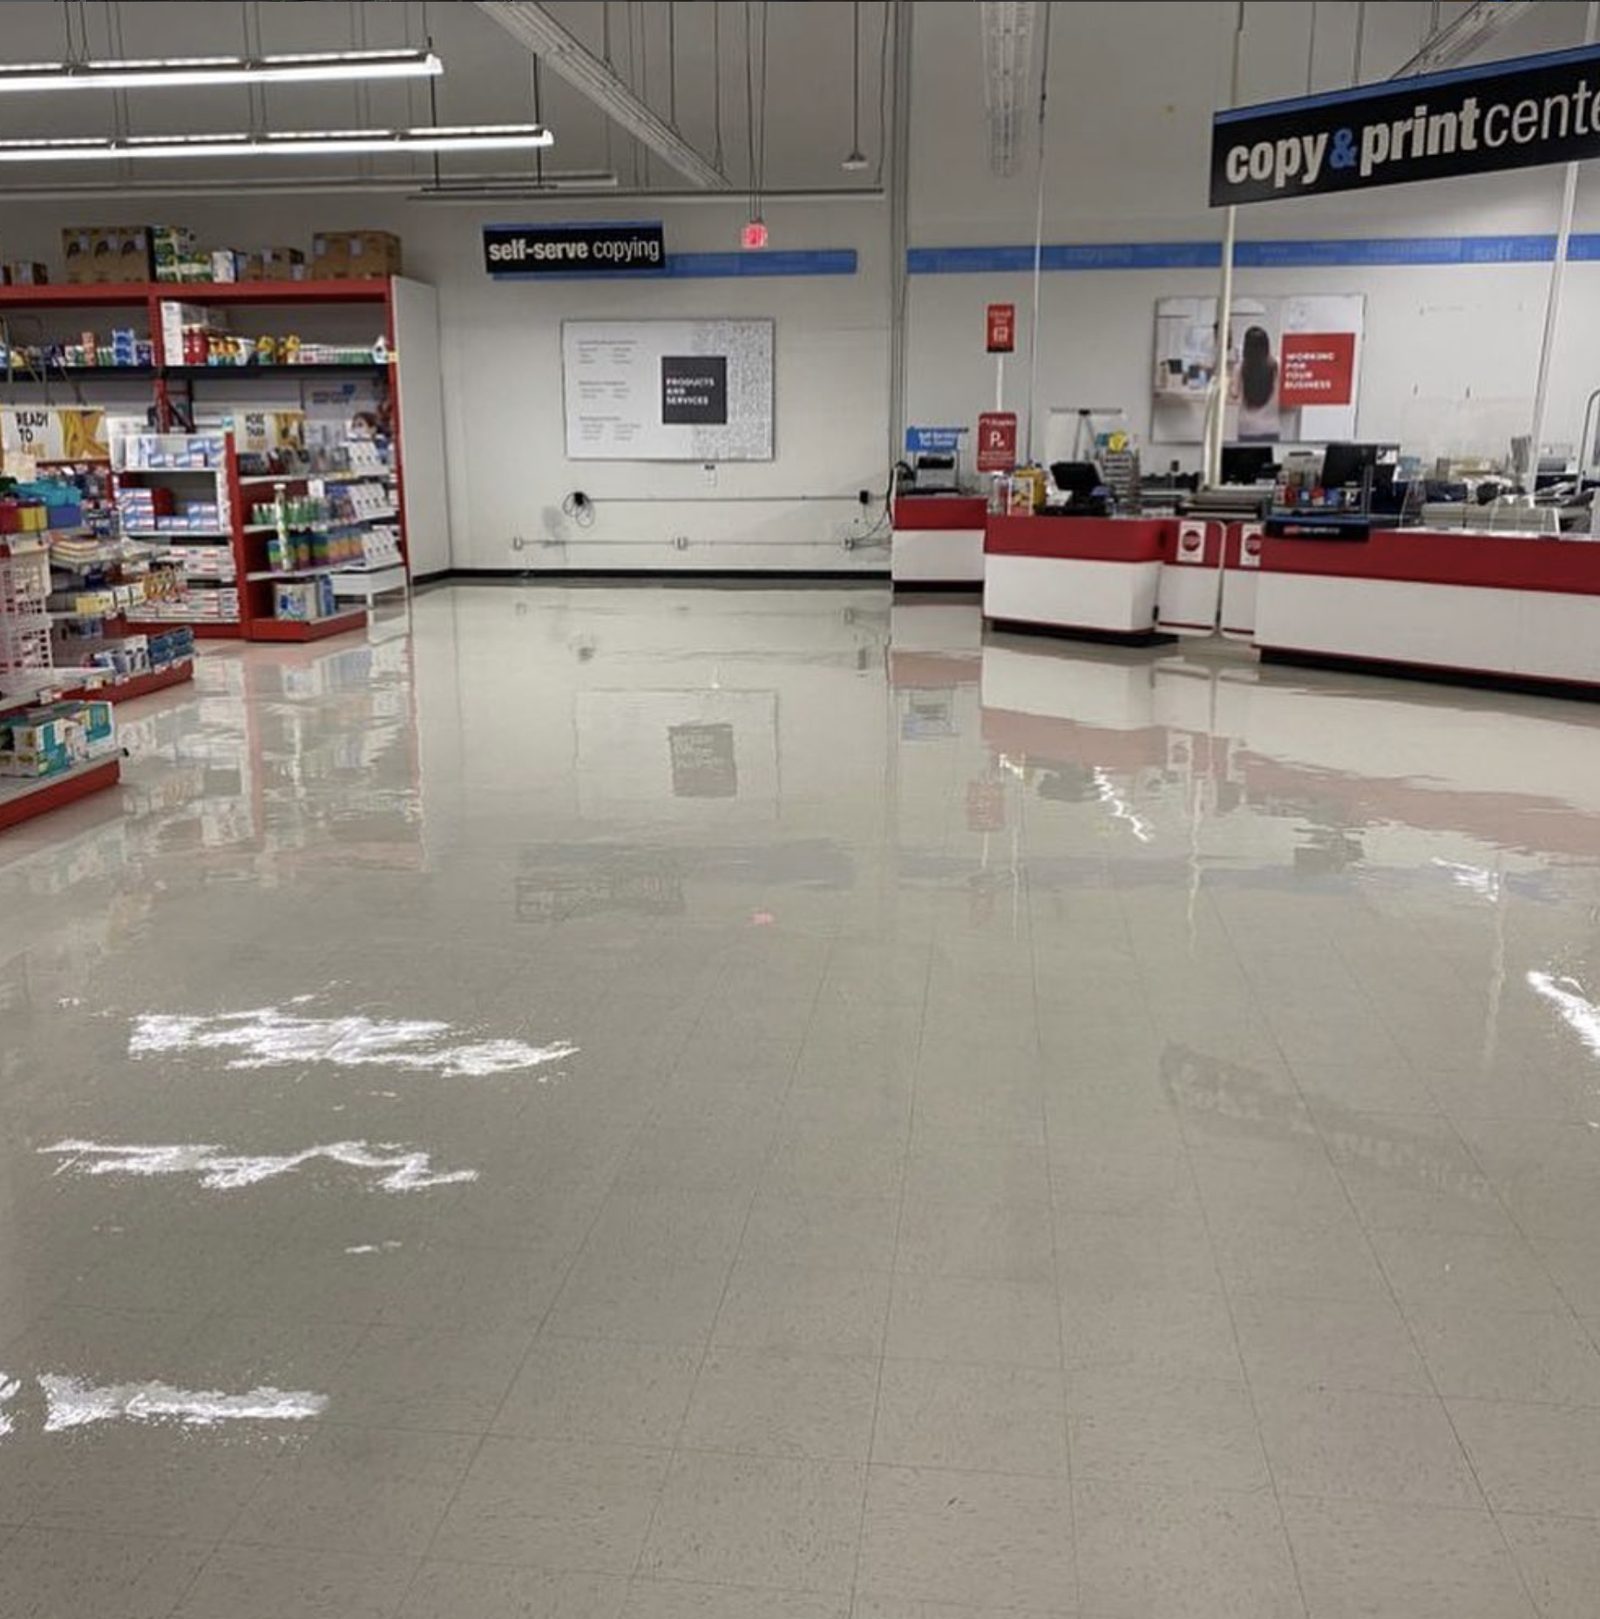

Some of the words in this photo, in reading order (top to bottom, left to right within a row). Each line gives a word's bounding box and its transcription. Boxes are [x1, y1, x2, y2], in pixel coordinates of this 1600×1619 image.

[1225, 132, 1329, 188] copy
[1329, 128, 1357, 170] &
[1359, 97, 1480, 177] print
[488, 238, 589, 261] self-serve
[592, 236, 660, 263] copying
[1285, 351, 1336, 361] WORKING
[1285, 361, 1307, 370] FOR
[1285, 370, 1314, 379] YOUR
[665, 377, 716, 388] PRODUCTS
[1284, 379, 1333, 390] BUSINESS
[665, 387, 687, 395] AND
[665, 395, 710, 406] SERVICES
[15, 411, 49, 428] READY
[18, 428, 34, 443] TO
